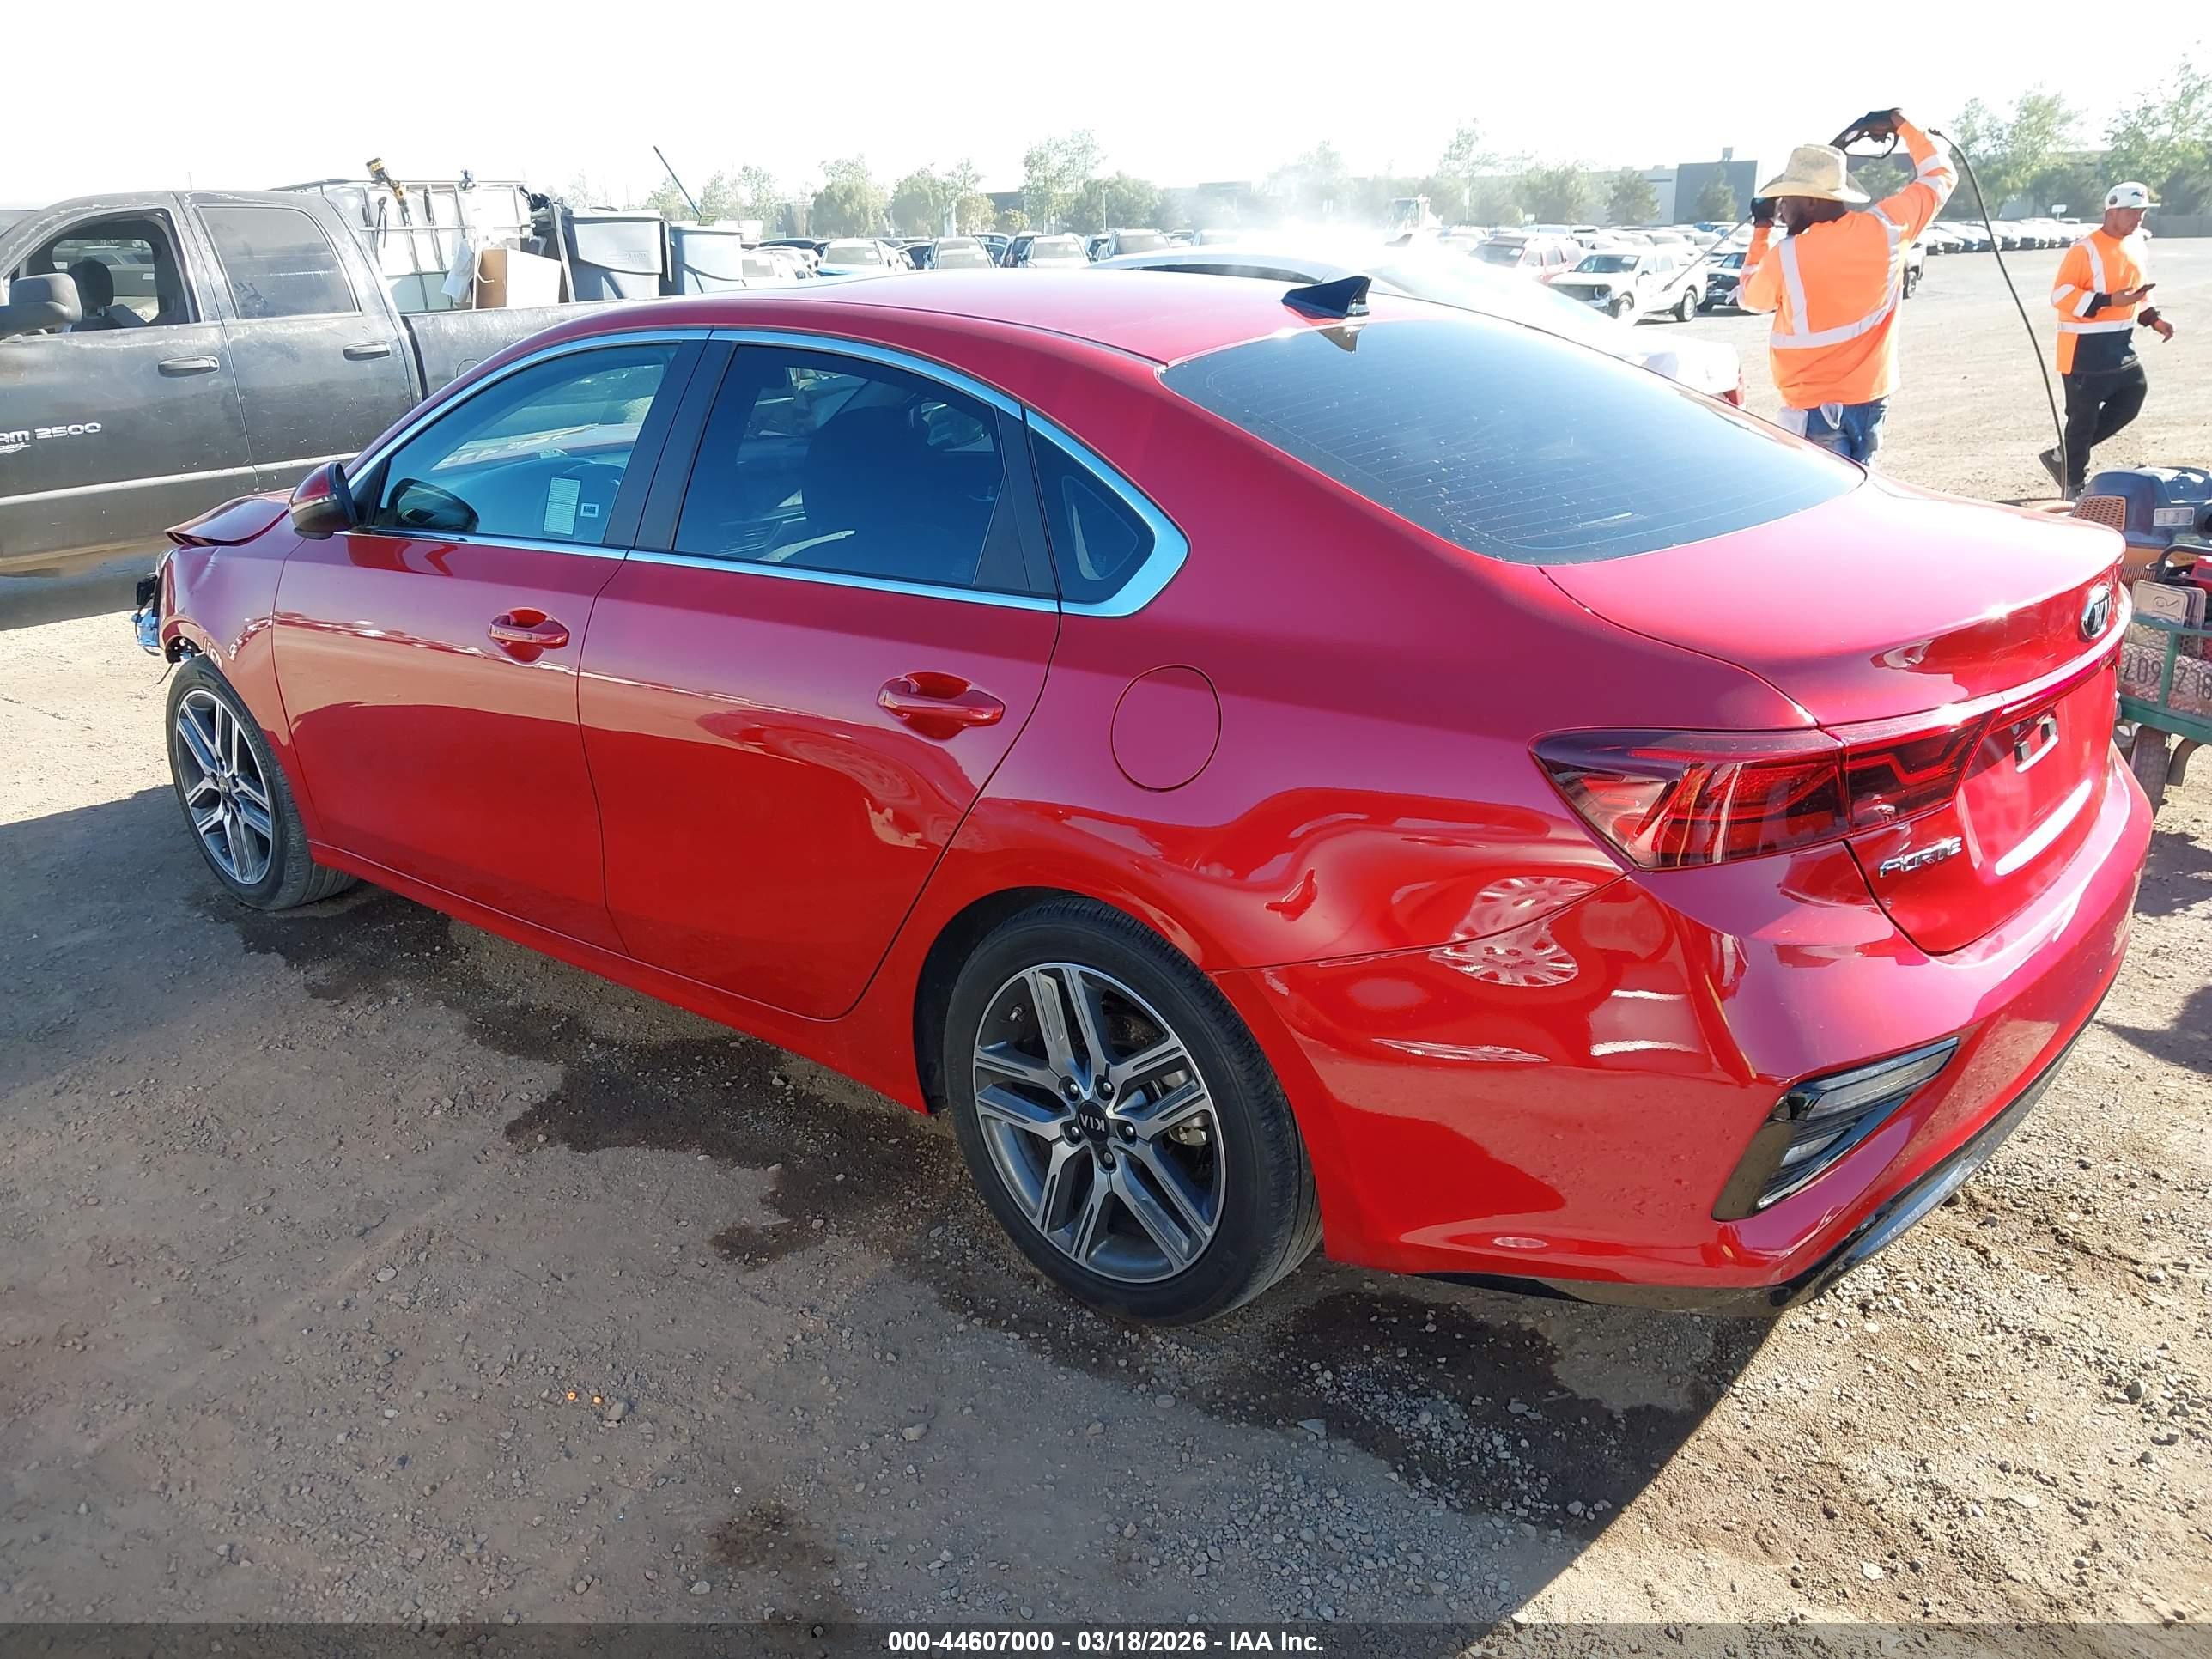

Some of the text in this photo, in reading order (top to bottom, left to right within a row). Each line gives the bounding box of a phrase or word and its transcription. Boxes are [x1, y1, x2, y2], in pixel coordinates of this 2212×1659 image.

[0, 422, 102, 443] AM 2500
[1879, 836, 1963, 878] FORTE
[1079, 1113, 1105, 1132] KIA
